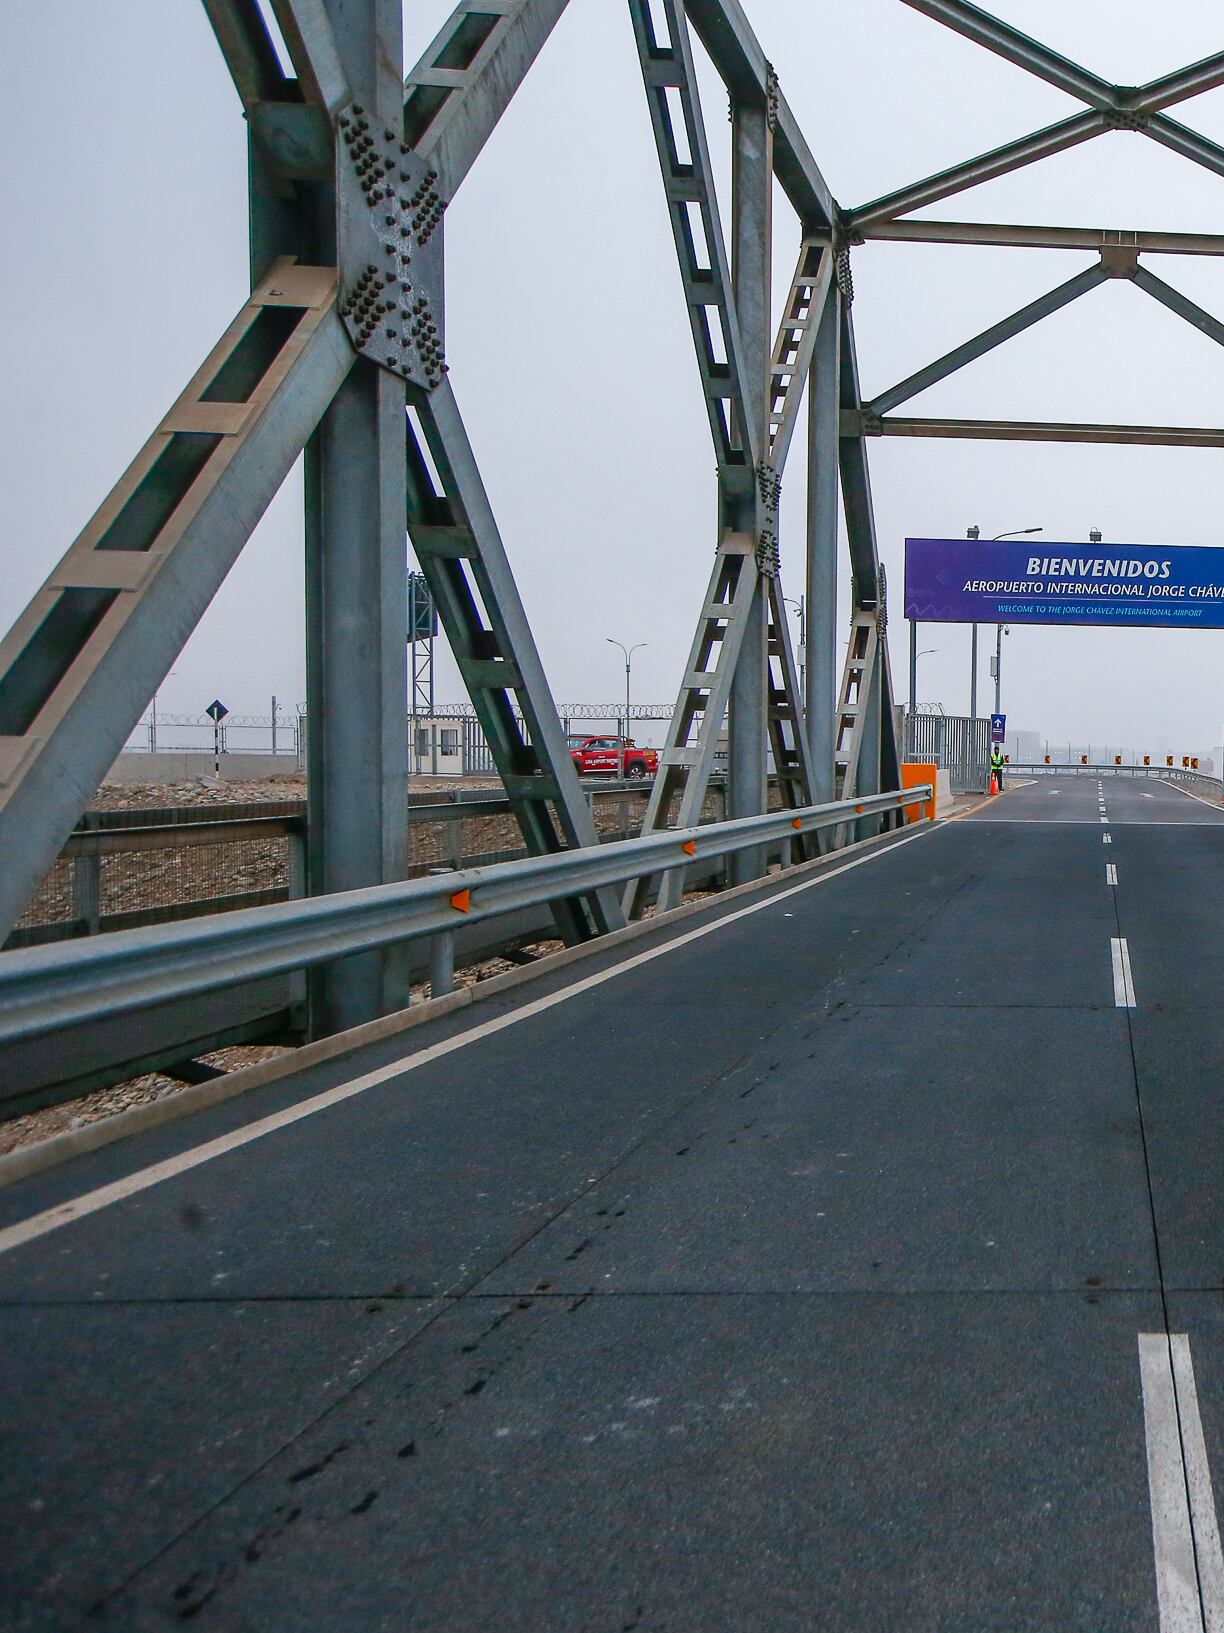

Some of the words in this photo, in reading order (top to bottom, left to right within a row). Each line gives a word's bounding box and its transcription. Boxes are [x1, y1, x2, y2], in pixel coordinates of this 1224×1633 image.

[1026, 557, 1172, 579] BIENVENIDOS
[963, 580, 1043, 594] AEROPUERTO
[1046, 582, 1145, 597] INTERNACIONAL
[1147, 584, 1186, 598] JORGE
[998, 605, 1034, 613] WELCOME
[1036, 605, 1046, 613] TO
[1048, 606, 1061, 614] THE
[1062, 606, 1085, 615] JORGE
[1115, 607, 1171, 616] INTERNATIONAL
[1172, 608, 1203, 617] AIRPORT
